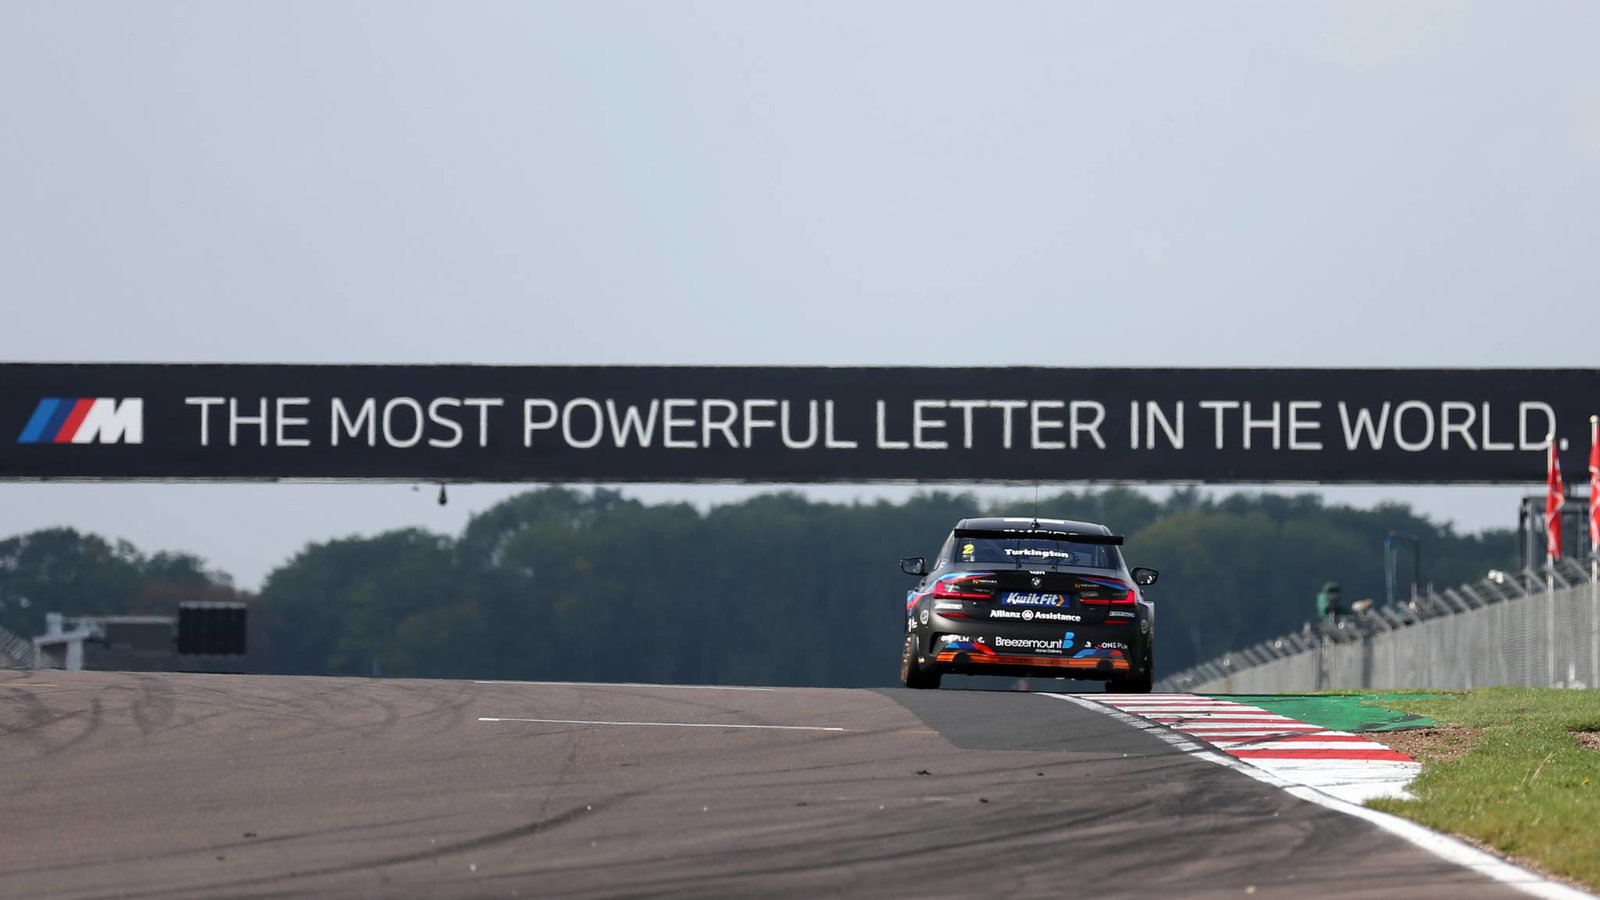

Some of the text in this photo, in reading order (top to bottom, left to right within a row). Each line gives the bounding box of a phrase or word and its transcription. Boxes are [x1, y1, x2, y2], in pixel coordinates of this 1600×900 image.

[185, 397, 1568, 452] THE MOST POWERFUL LETTER IN THE WORLD.
[962, 543, 975, 555] 2
[1004, 548, 1069, 559] Turkington
[990, 610, 1081, 622] Allianz Assistance
[995, 636, 1063, 649] Breezemount
